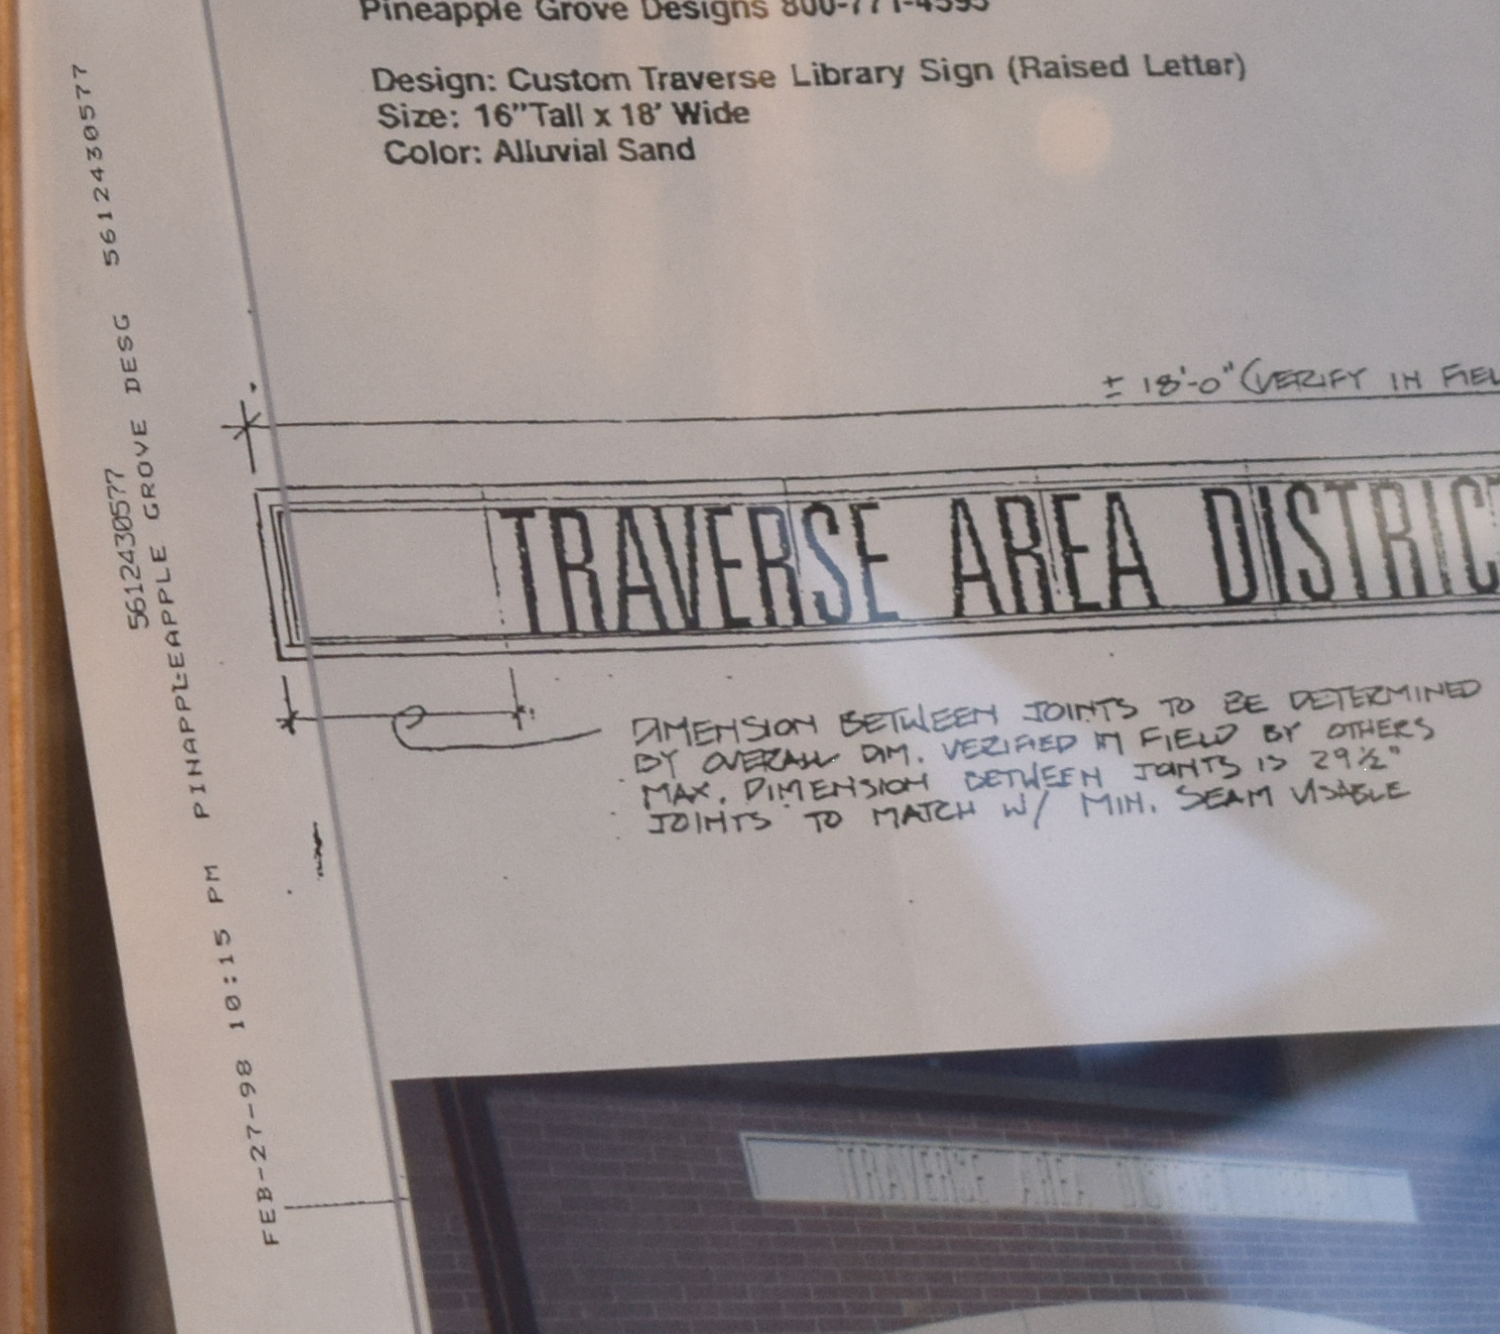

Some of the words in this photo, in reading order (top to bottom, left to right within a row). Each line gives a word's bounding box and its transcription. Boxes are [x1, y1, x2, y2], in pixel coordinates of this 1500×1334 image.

[371, 66, 498, 99] Design:
[507, 67, 632, 93] Custom
[638, 65, 777, 91] Traverse
[792, 62, 905, 89] Library
[919, 57, 995, 88] Sign
[1006, 53, 1130, 86] (Raised
[1143, 52, 1247, 82] Letter)
[377, 103, 460, 130] Size:
[593, 107, 612, 127] x
[625, 102, 663, 127] 18'
[672, 100, 751, 125] Wide
[70, 61, 123, 266] 5612430577
[384, 139, 483, 165] Color:
[494, 137, 607, 163] Alluvial
[617, 136, 697, 163] Sand
[111, 311, 143, 392] DESG
[129, 417, 163, 520] GROVE
[103, 465, 151, 630] 5612430577
[498, 500, 902, 635] TRAVERSE
[947, 491, 1161, 621] AREA
[632, 713, 818, 747] DIMENSION
[839, 703, 999, 737] BETWEEN
[1023, 695, 1138, 725] JOINTS
[1159, 695, 1196, 718] TO
[1224, 689, 1268, 715] BE
[1288, 678, 1483, 712] DETERMINED
[633, 748, 680, 779] BY
[1140, 723, 1239, 752] FIELD
[1263, 722, 1301, 744] BY
[1325, 716, 1437, 741] OTHERS
[641, 781, 727, 810] MAX.
[743, 772, 929, 804] DIMENSION
[964, 765, 1103, 791] BETWEEN
[1133, 755, 1242, 783] JOINTS
[648, 810, 773, 835] JOINTS
[804, 811, 844, 832] TO
[873, 800, 977, 828] MATCH
[1003, 790, 1049, 829] W/
[1082, 791, 1157, 818] MIN.
[1179, 783, 1274, 811] SEAM
[202, 863, 225, 904] PM
[212, 927, 247, 1030] 10:15
[233, 1056, 281, 1247] FEB-27-98
